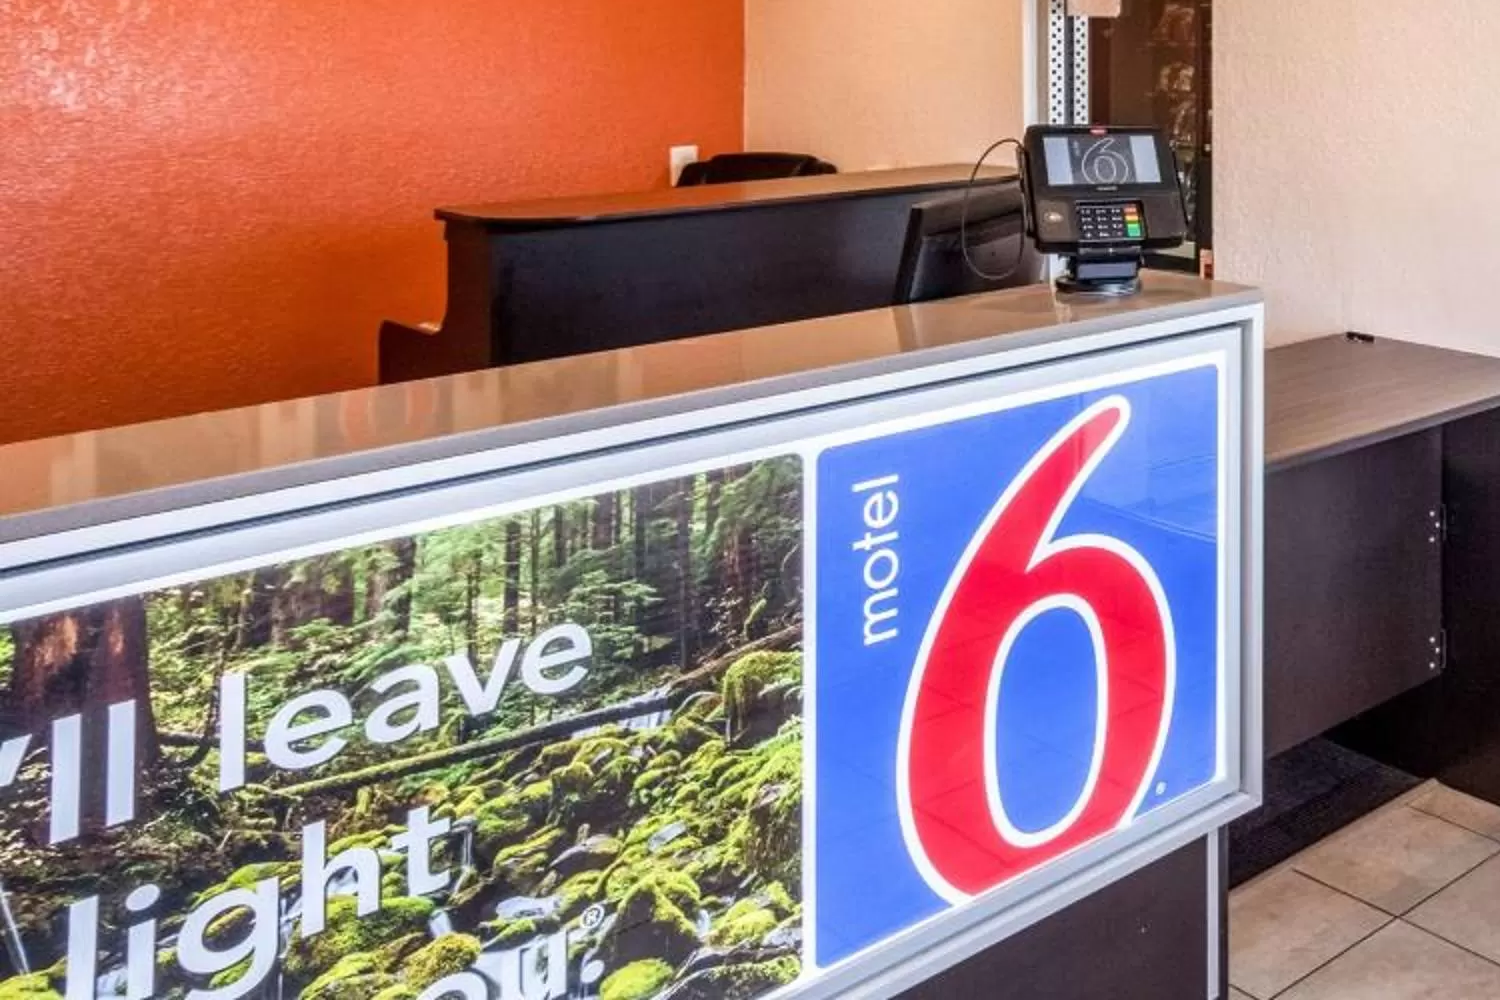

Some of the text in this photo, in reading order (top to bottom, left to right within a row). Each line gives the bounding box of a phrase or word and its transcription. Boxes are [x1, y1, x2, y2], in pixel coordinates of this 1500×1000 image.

[851, 473, 899, 646] motel
[896, 394, 1177, 907] 6
[219, 622, 593, 793] leave
[66, 805, 452, 1000] light
